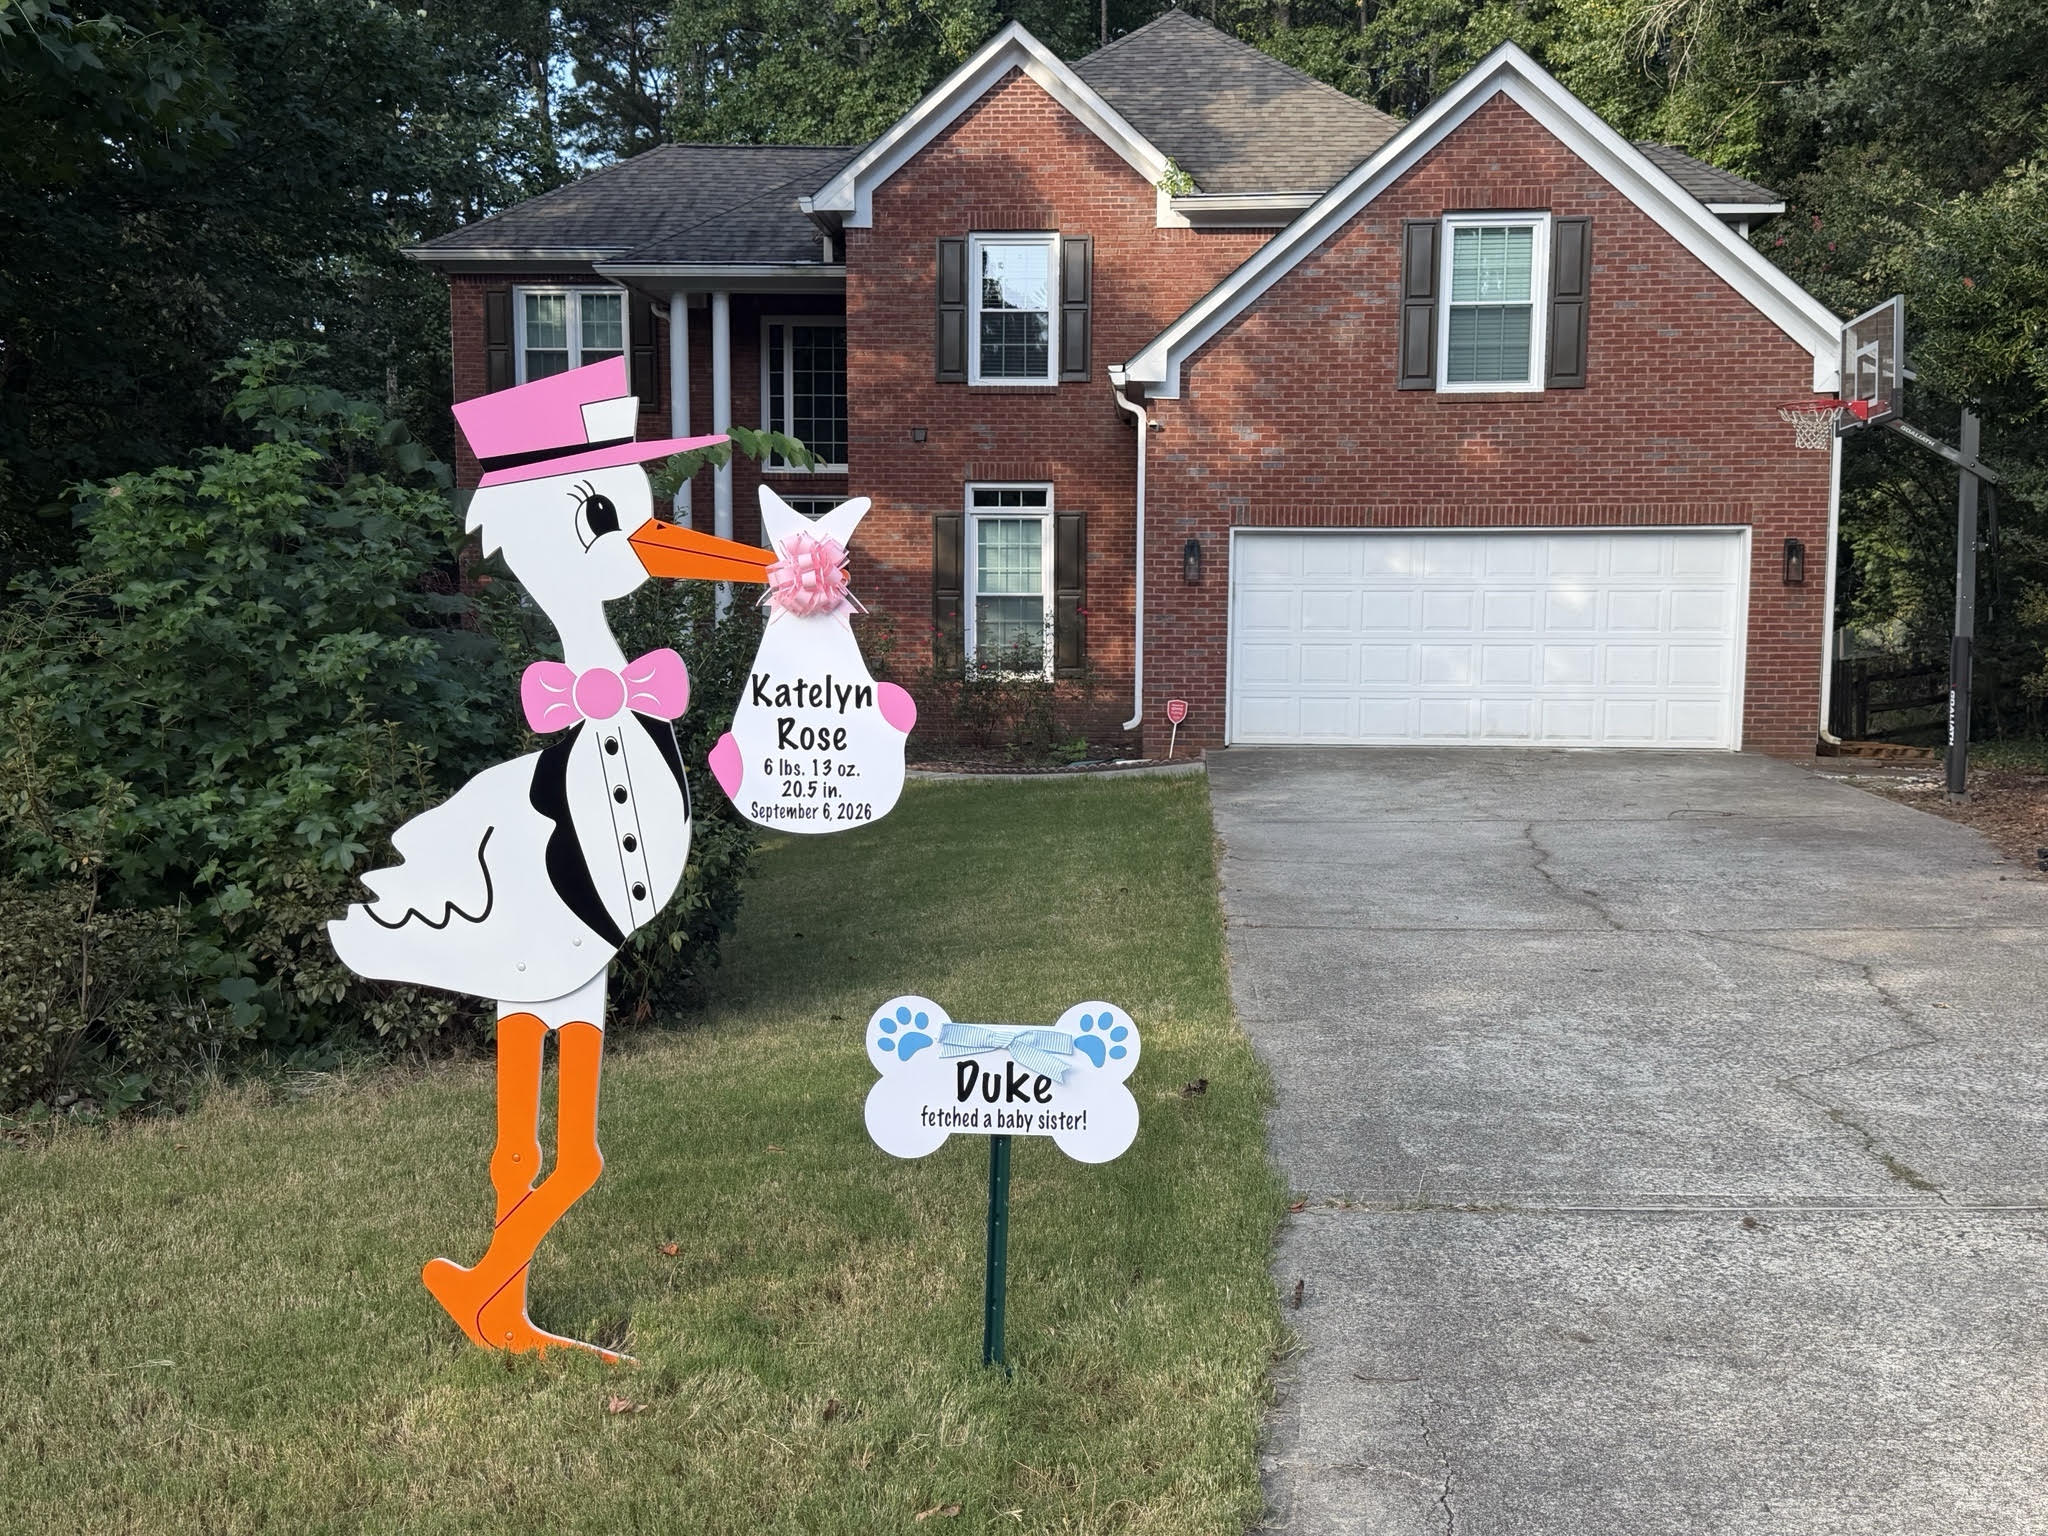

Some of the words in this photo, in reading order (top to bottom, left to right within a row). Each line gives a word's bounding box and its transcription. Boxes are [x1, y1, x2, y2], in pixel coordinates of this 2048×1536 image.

[752, 673, 873, 714] Katelyn
[777, 717, 848, 751] Rose
[764, 758, 773, 776] 6
[779, 758, 805, 776] lbs.
[812, 759, 832, 776] 13
[838, 764, 860, 777] oz.
[781, 780, 817, 798] 20.5
[823, 781, 842, 798] in.
[751, 801, 819, 822] September
[822, 803, 833, 822] 6,
[837, 803, 872, 820] 2026
[957, 1060, 1053, 1104] Duke
[921, 1105, 979, 1128] fetched
[983, 1113, 992, 1128] a
[997, 1109, 1034, 1133] baby
[1038, 1110, 1087, 1130] sister!
